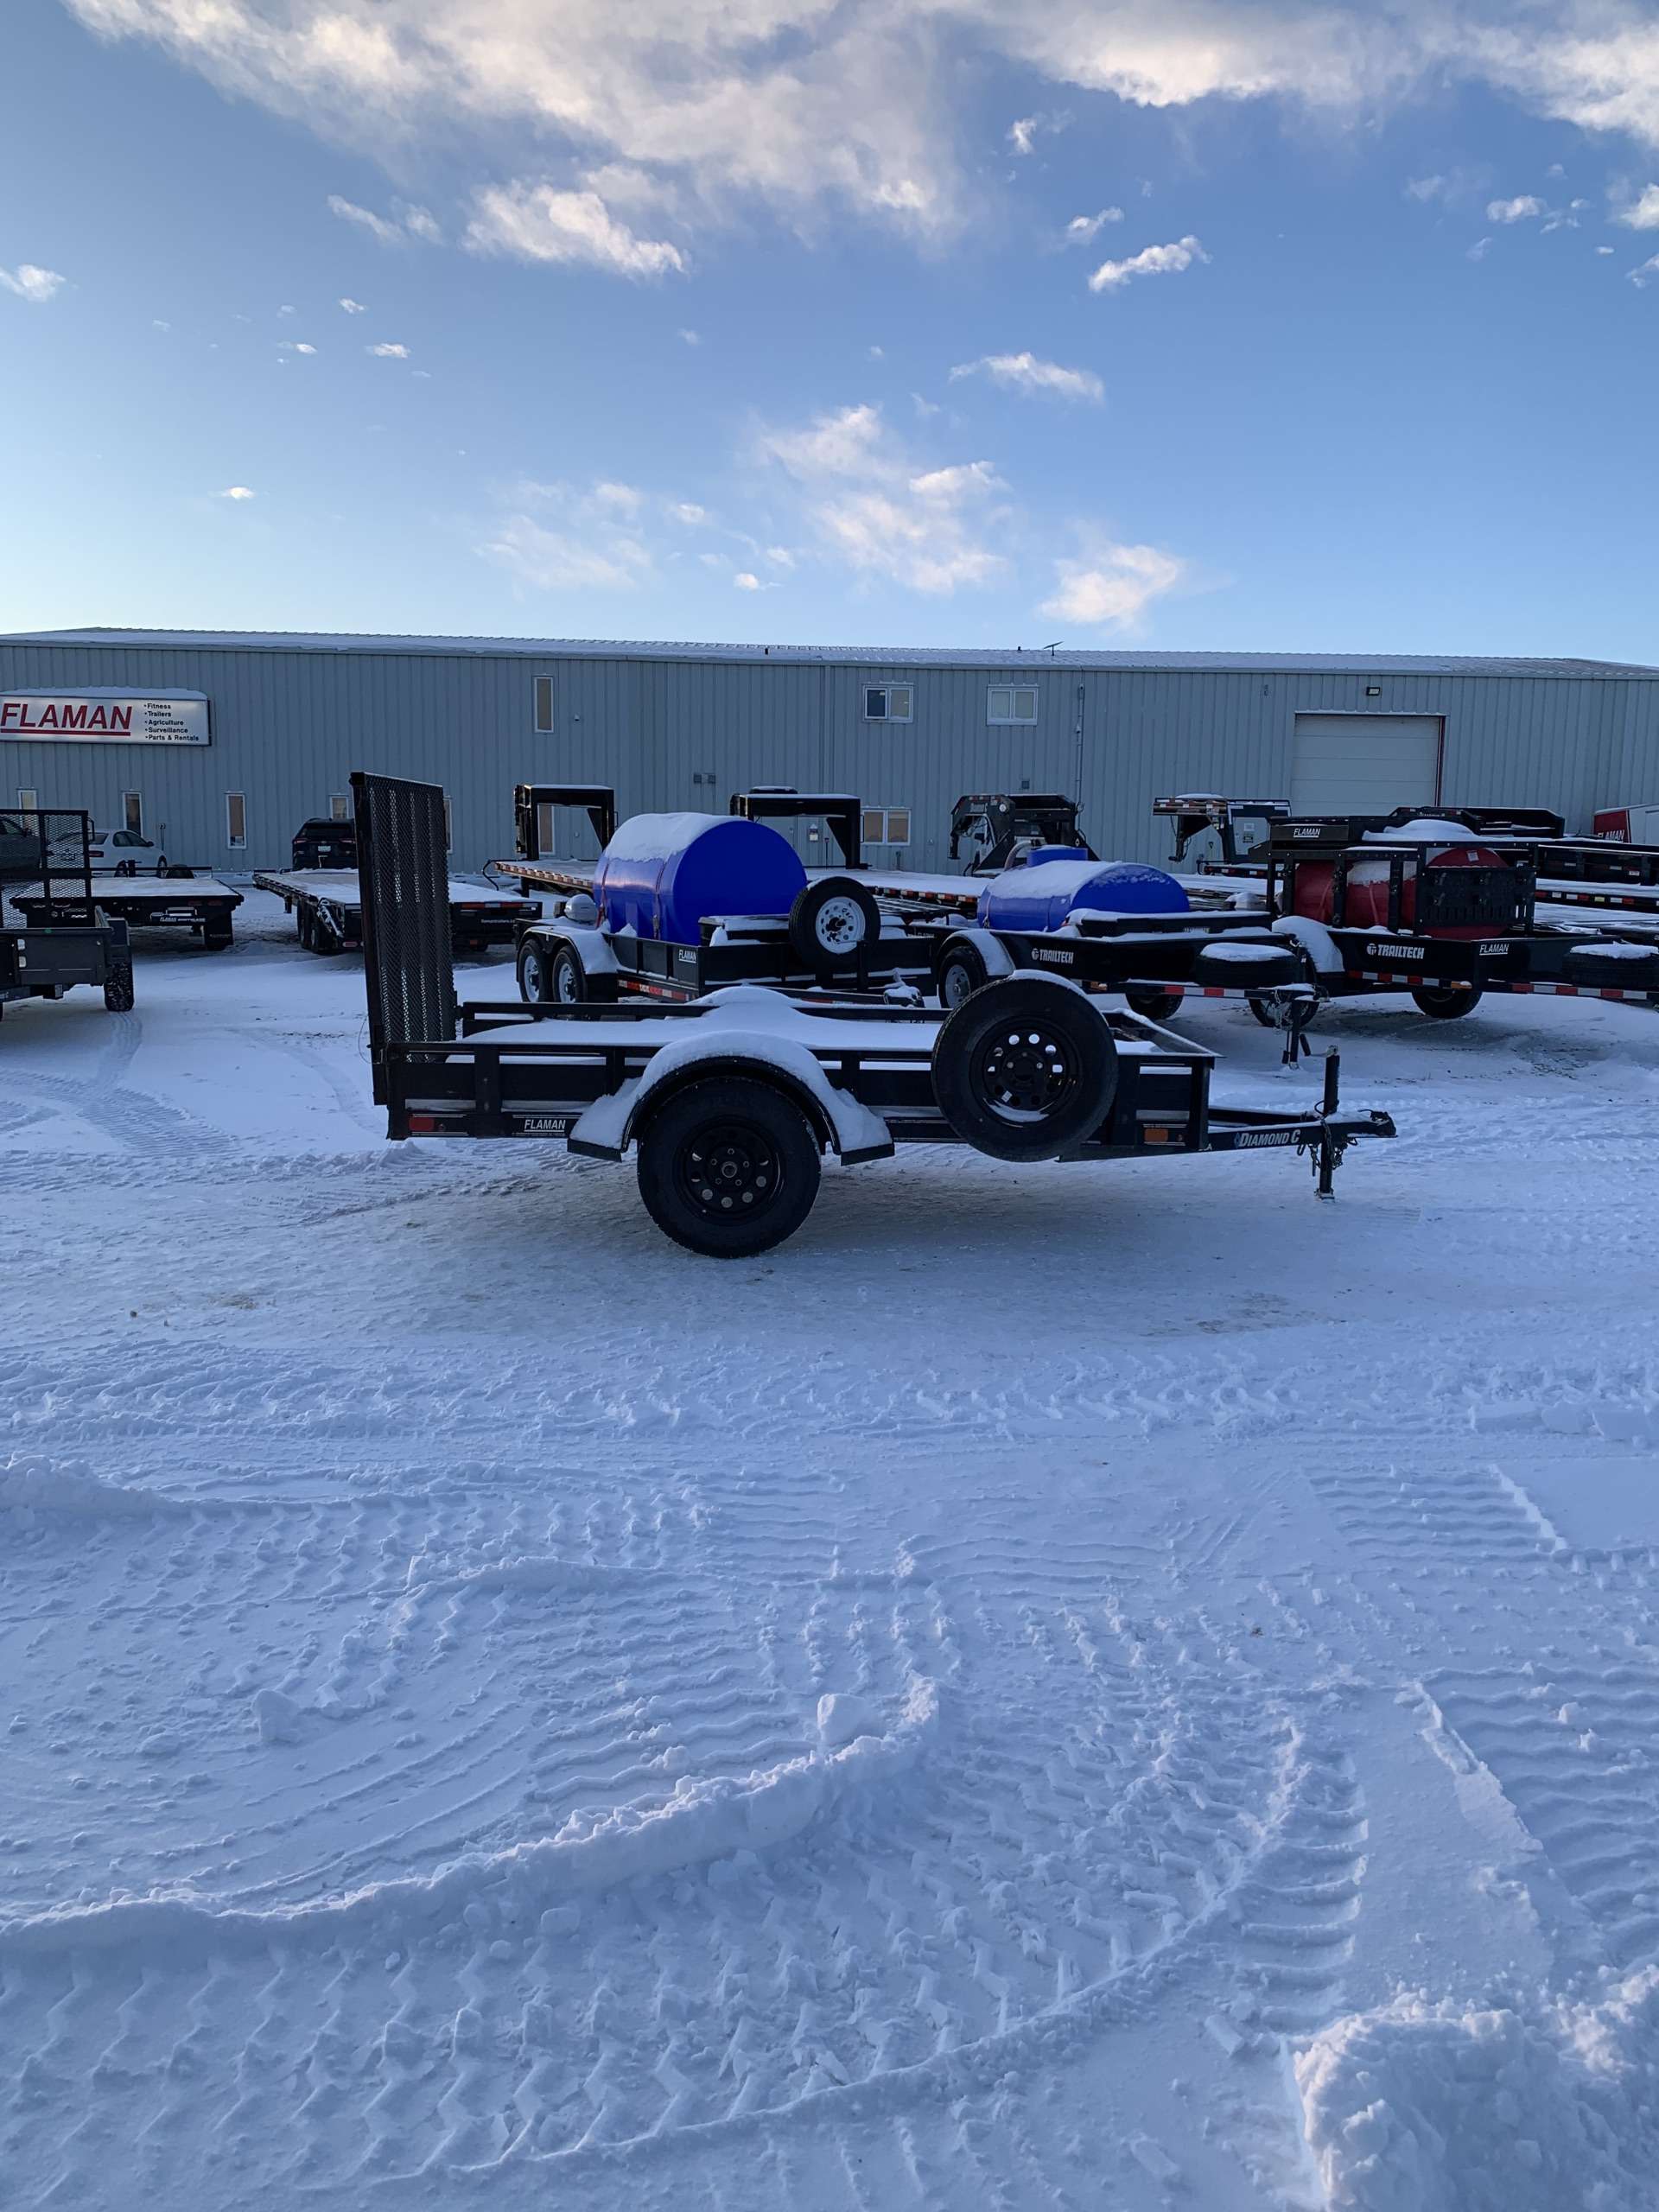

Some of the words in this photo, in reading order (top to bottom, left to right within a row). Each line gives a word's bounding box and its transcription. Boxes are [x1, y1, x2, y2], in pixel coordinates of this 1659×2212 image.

[0, 702, 132, 729] FLAMAN
[1294, 828, 1321, 836] FLAMAN
[1377, 944, 1425, 959] TRAILTECH
[1479, 944, 1510, 953] FLAMAN
[1039, 949, 1074, 964] TRAILTECH
[524, 1119, 566, 1129] FLAMAN
[1238, 1132, 1290, 1147] DIAMOND
[1290, 1128, 1301, 1143] C
